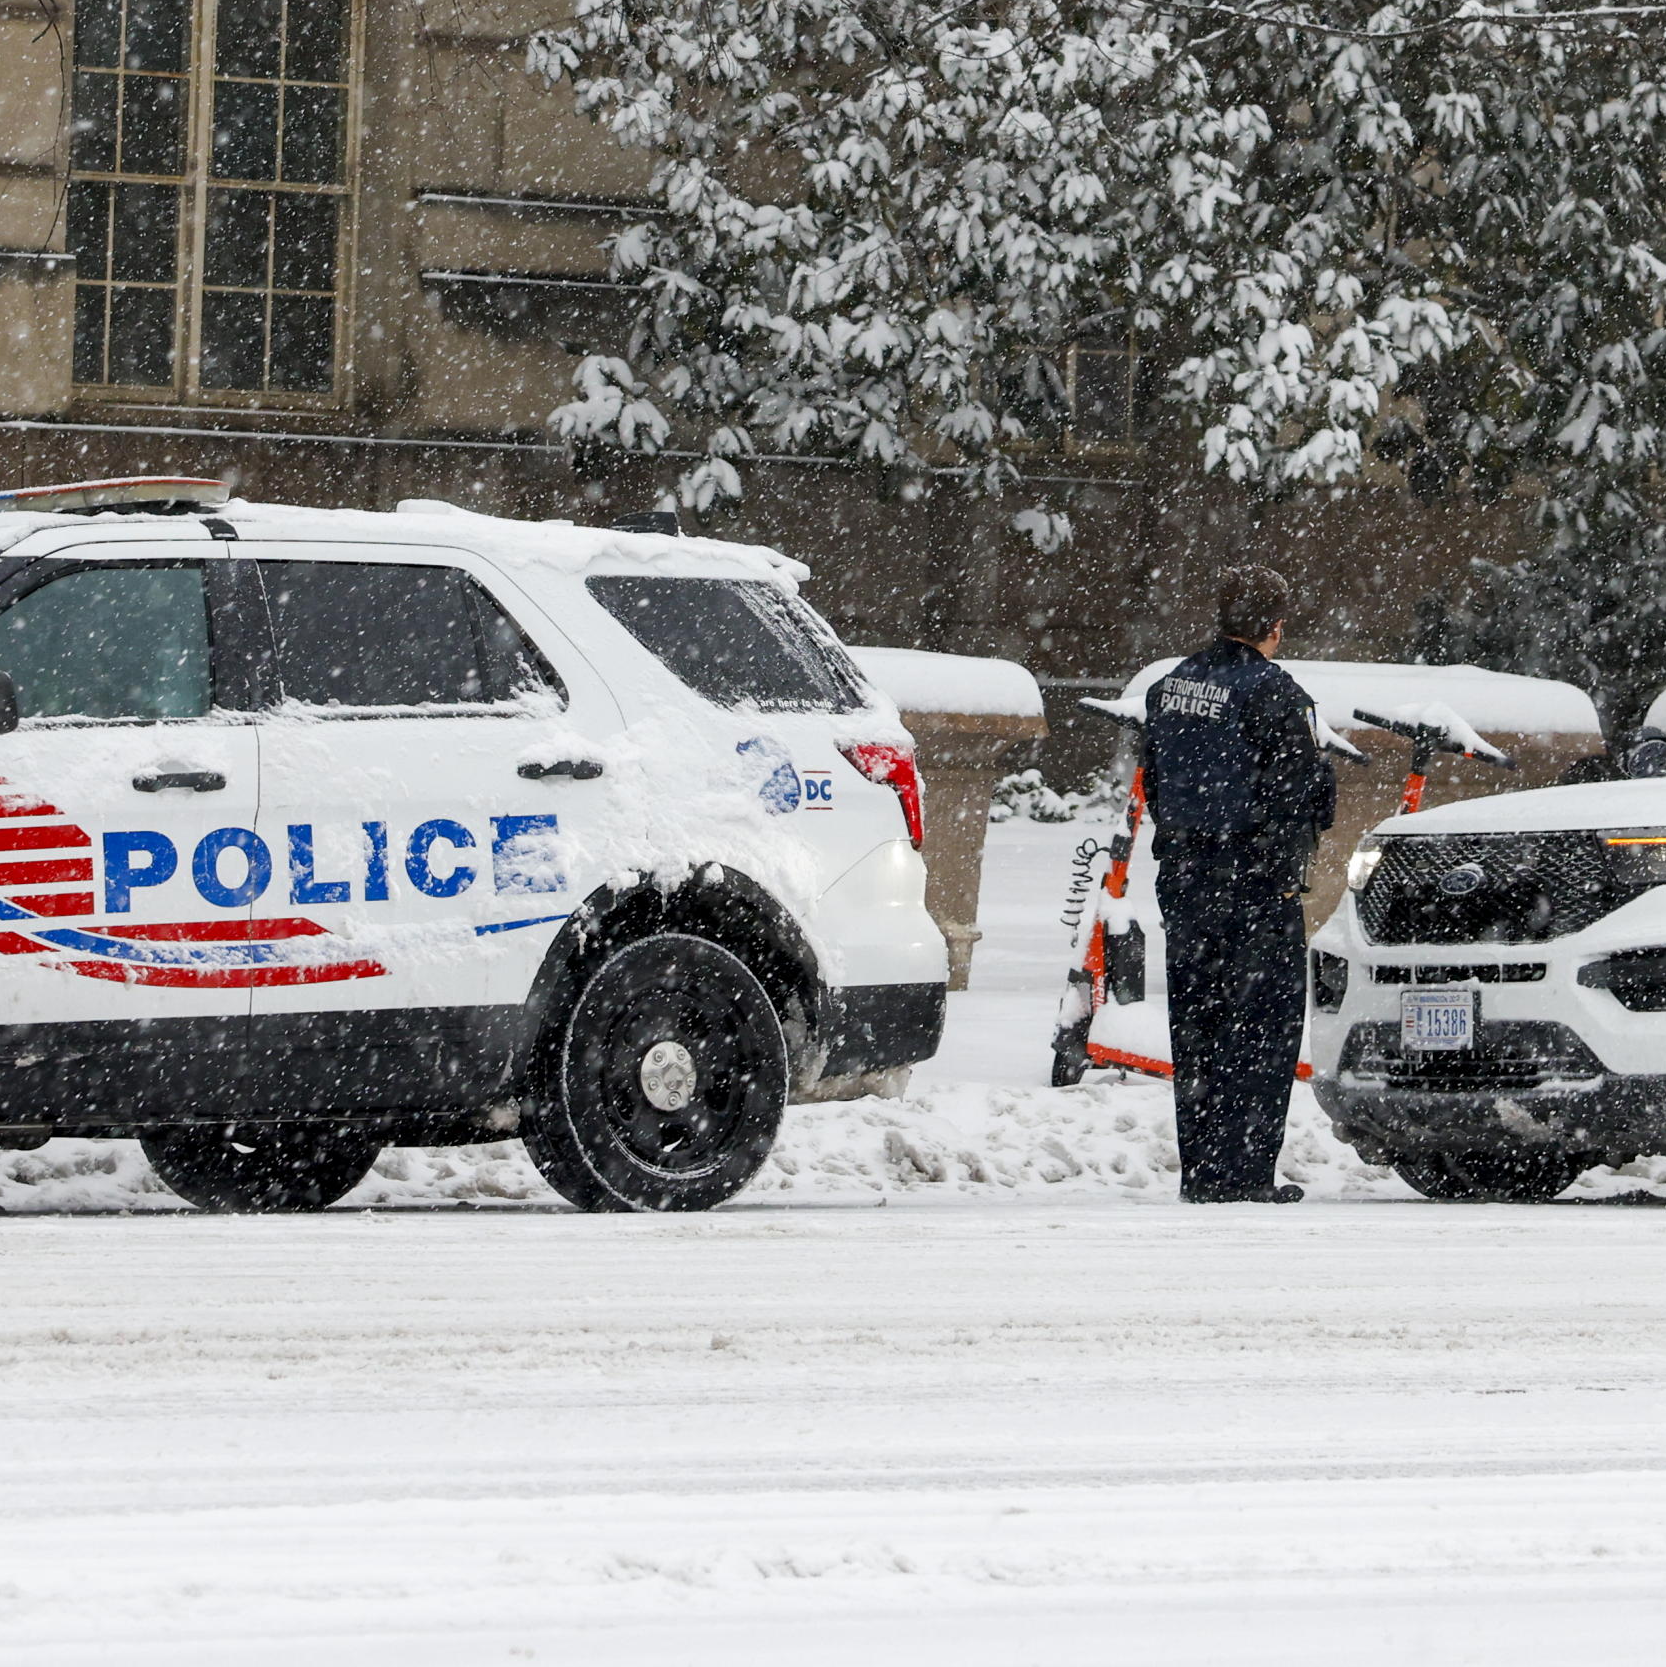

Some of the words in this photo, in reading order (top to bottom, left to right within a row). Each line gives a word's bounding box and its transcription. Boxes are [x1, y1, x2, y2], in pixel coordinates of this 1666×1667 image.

[760, 699, 775, 707] are
[778, 698, 798, 707] here
[800, 699, 811, 707] to
[1163, 676, 1231, 703] METROPOLITAN
[1160, 693, 1223, 719] POLICE
[805, 779, 832, 801] DC
[103, 814, 566, 913] POLICE
[1426, 1008, 1466, 1037] 15386
